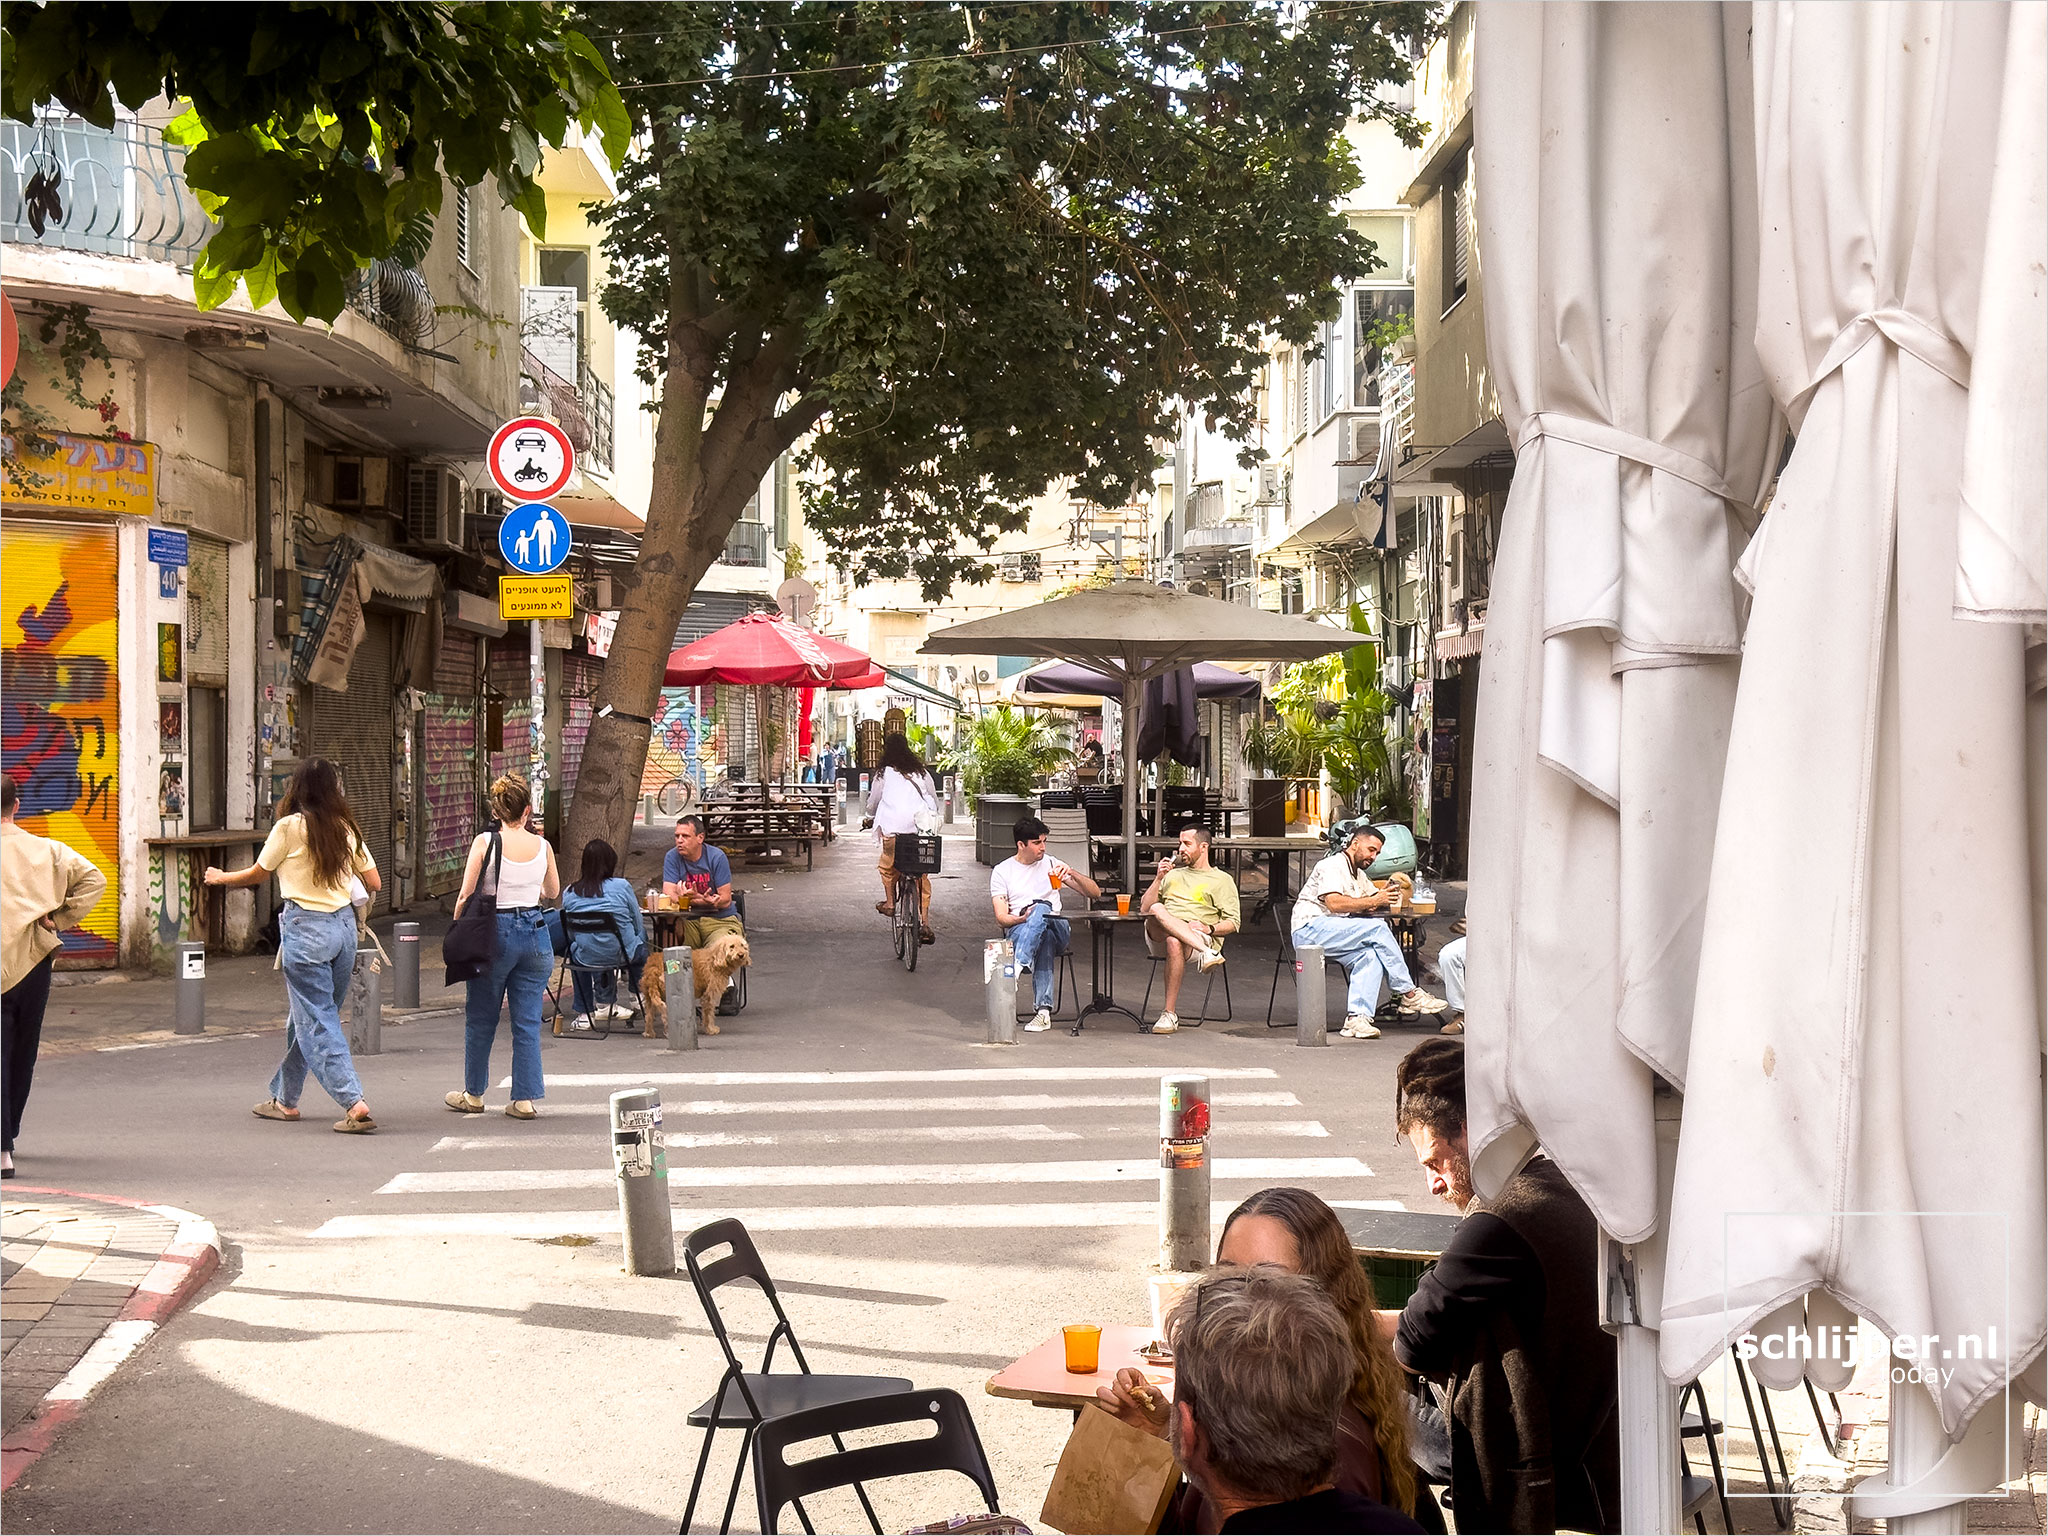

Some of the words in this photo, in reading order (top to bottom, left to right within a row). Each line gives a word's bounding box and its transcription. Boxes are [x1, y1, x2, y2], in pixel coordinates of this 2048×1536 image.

[33, 491, 96, 504] לוינסק
[162, 570, 176, 591] 40
[505, 586, 538, 595] אופניים
[541, 584, 567, 594] למעט
[510, 602, 548, 611] ממונעים
[550, 600, 563, 609] לא
